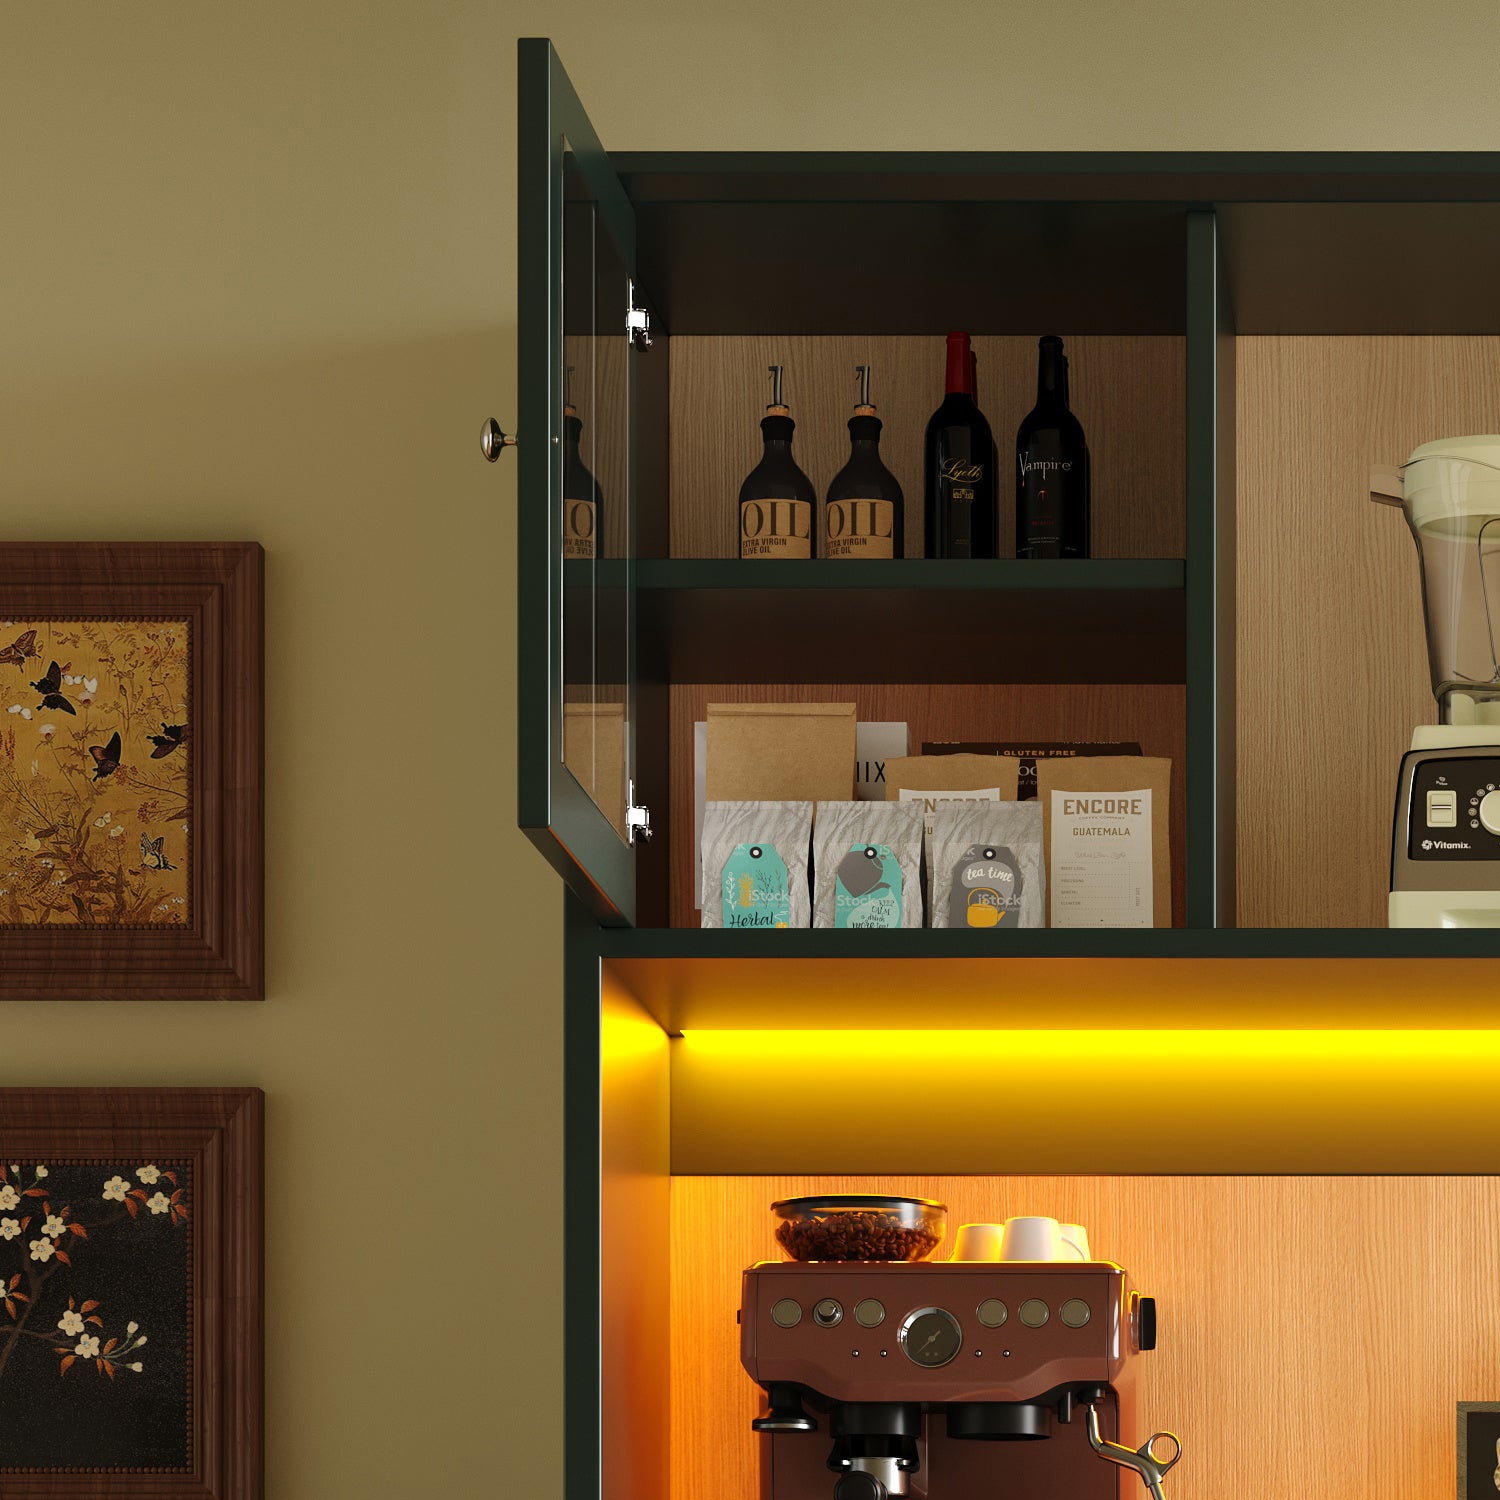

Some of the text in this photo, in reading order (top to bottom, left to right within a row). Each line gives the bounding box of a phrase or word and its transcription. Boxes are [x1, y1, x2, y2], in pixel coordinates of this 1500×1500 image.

[1018, 451, 1073, 481] Vampire
[742, 500, 810, 539] OIL
[827, 500, 892, 539] OIL
[742, 537, 788, 549] EXTRA VIRGIN
[850, 537, 868, 547] VIRGIN
[759, 546, 772, 554] OIL
[841, 546, 852, 554] OIL
[1063, 799, 1142, 815] ENCORE
[1072, 827, 1131, 836] GUATEMALA
[1432, 840, 1469, 850] Vitamix
[966, 866, 1013, 882] tea time
[729, 911, 776, 928] Herbal
